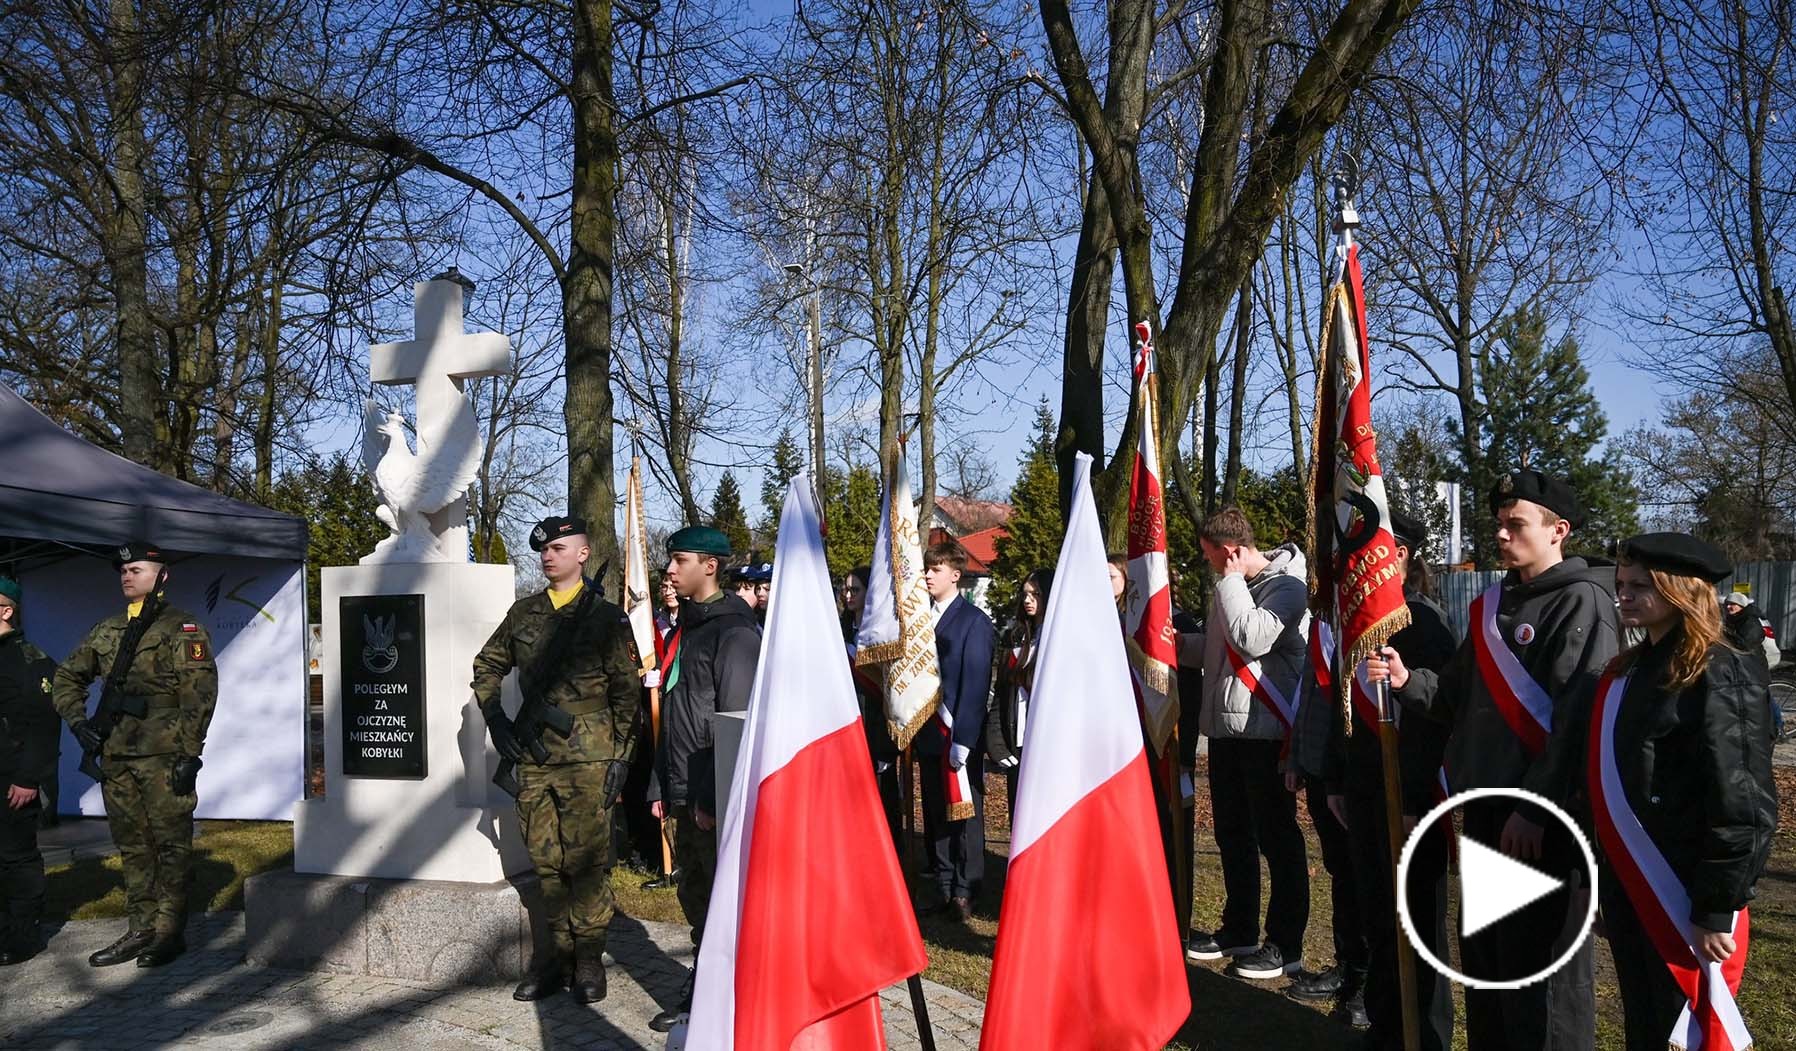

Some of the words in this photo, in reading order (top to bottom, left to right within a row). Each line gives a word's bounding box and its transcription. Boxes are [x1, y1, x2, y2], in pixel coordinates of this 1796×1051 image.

[1341, 545, 1390, 596] OBWÓD
[354, 683, 408, 694] POLEGŁYM
[374, 700, 388, 710] ZA
[356, 716, 407, 728] OJCZYZNĘ
[350, 729, 414, 742] MIESZKAŃCY
[361, 747, 403, 758] KOBYŁKI
